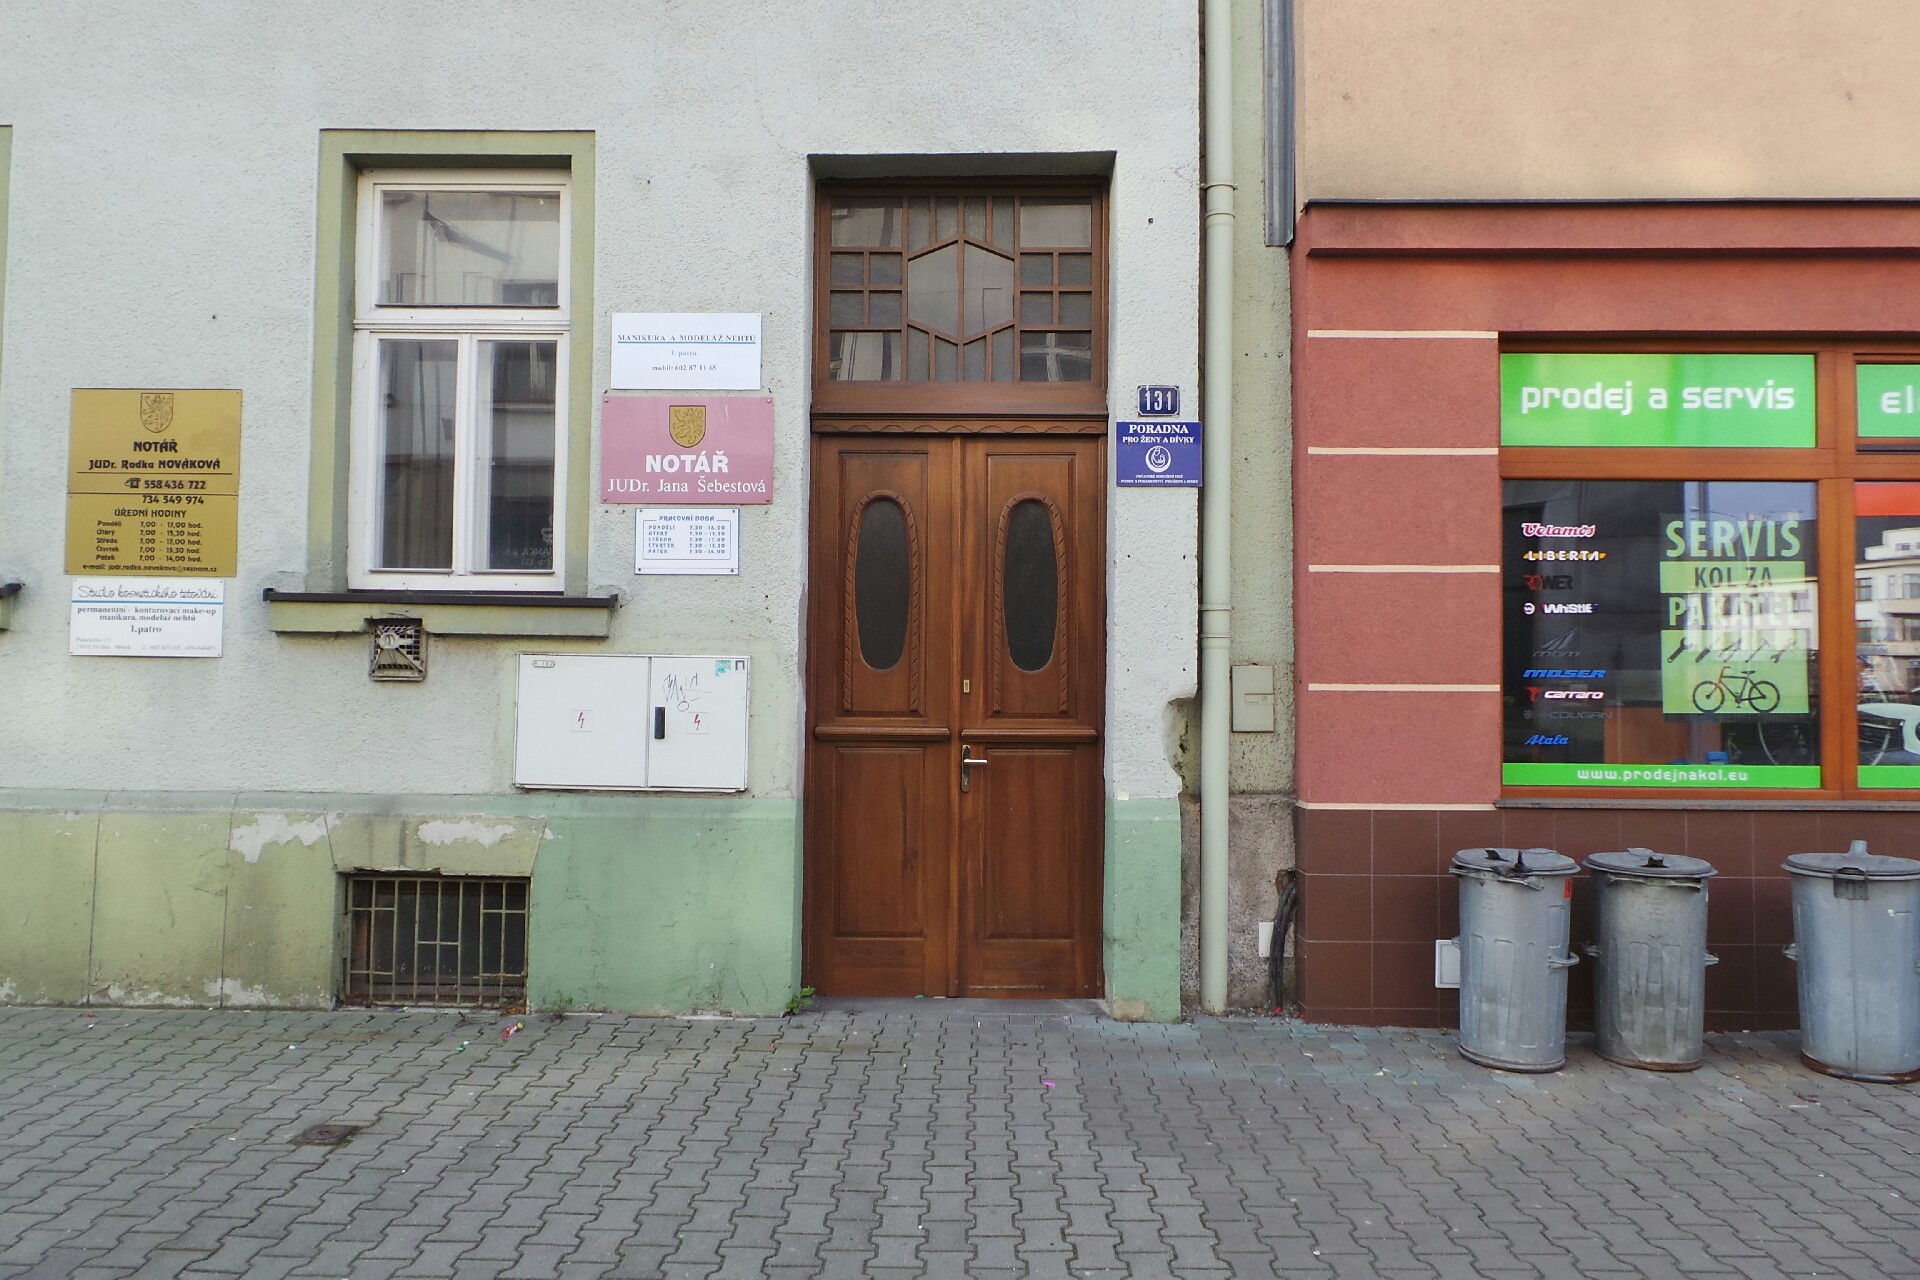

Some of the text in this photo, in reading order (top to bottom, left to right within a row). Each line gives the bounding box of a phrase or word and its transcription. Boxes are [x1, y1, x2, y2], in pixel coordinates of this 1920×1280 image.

[618, 334, 666, 342] MANIKURA
[1145, 390, 1172, 411] 131
[1521, 380, 1795, 416] prodej a servis
[1881, 385, 1920, 414] el
[1129, 424, 1189, 433] PORADNA
[133, 439, 178, 453] NOTÁŘ
[1140, 435, 1161, 443] ŽENY
[1169, 435, 1195, 443] DÍVKY
[89, 458, 220, 470] JUDr. Radka NOVÁKOVÁ
[646, 451, 728, 472] NOTÁŘ
[144, 480, 206, 490] 558 436 722
[608, 475, 766, 493] JUDr. Jana Šebestová
[142, 495, 204, 505] 734 549 974
[114, 508, 187, 518] ÚŘEDNÍ HODINY
[1521, 523, 1596, 538] Velamos
[1666, 520, 1801, 558] SERVIS
[1528, 551, 1600, 561] LIBERTA
[1694, 566, 1773, 588] KOL ZA
[1524, 735, 1569, 745] Atala
[1577, 768, 1748, 783] www.prodejnakol.eu
